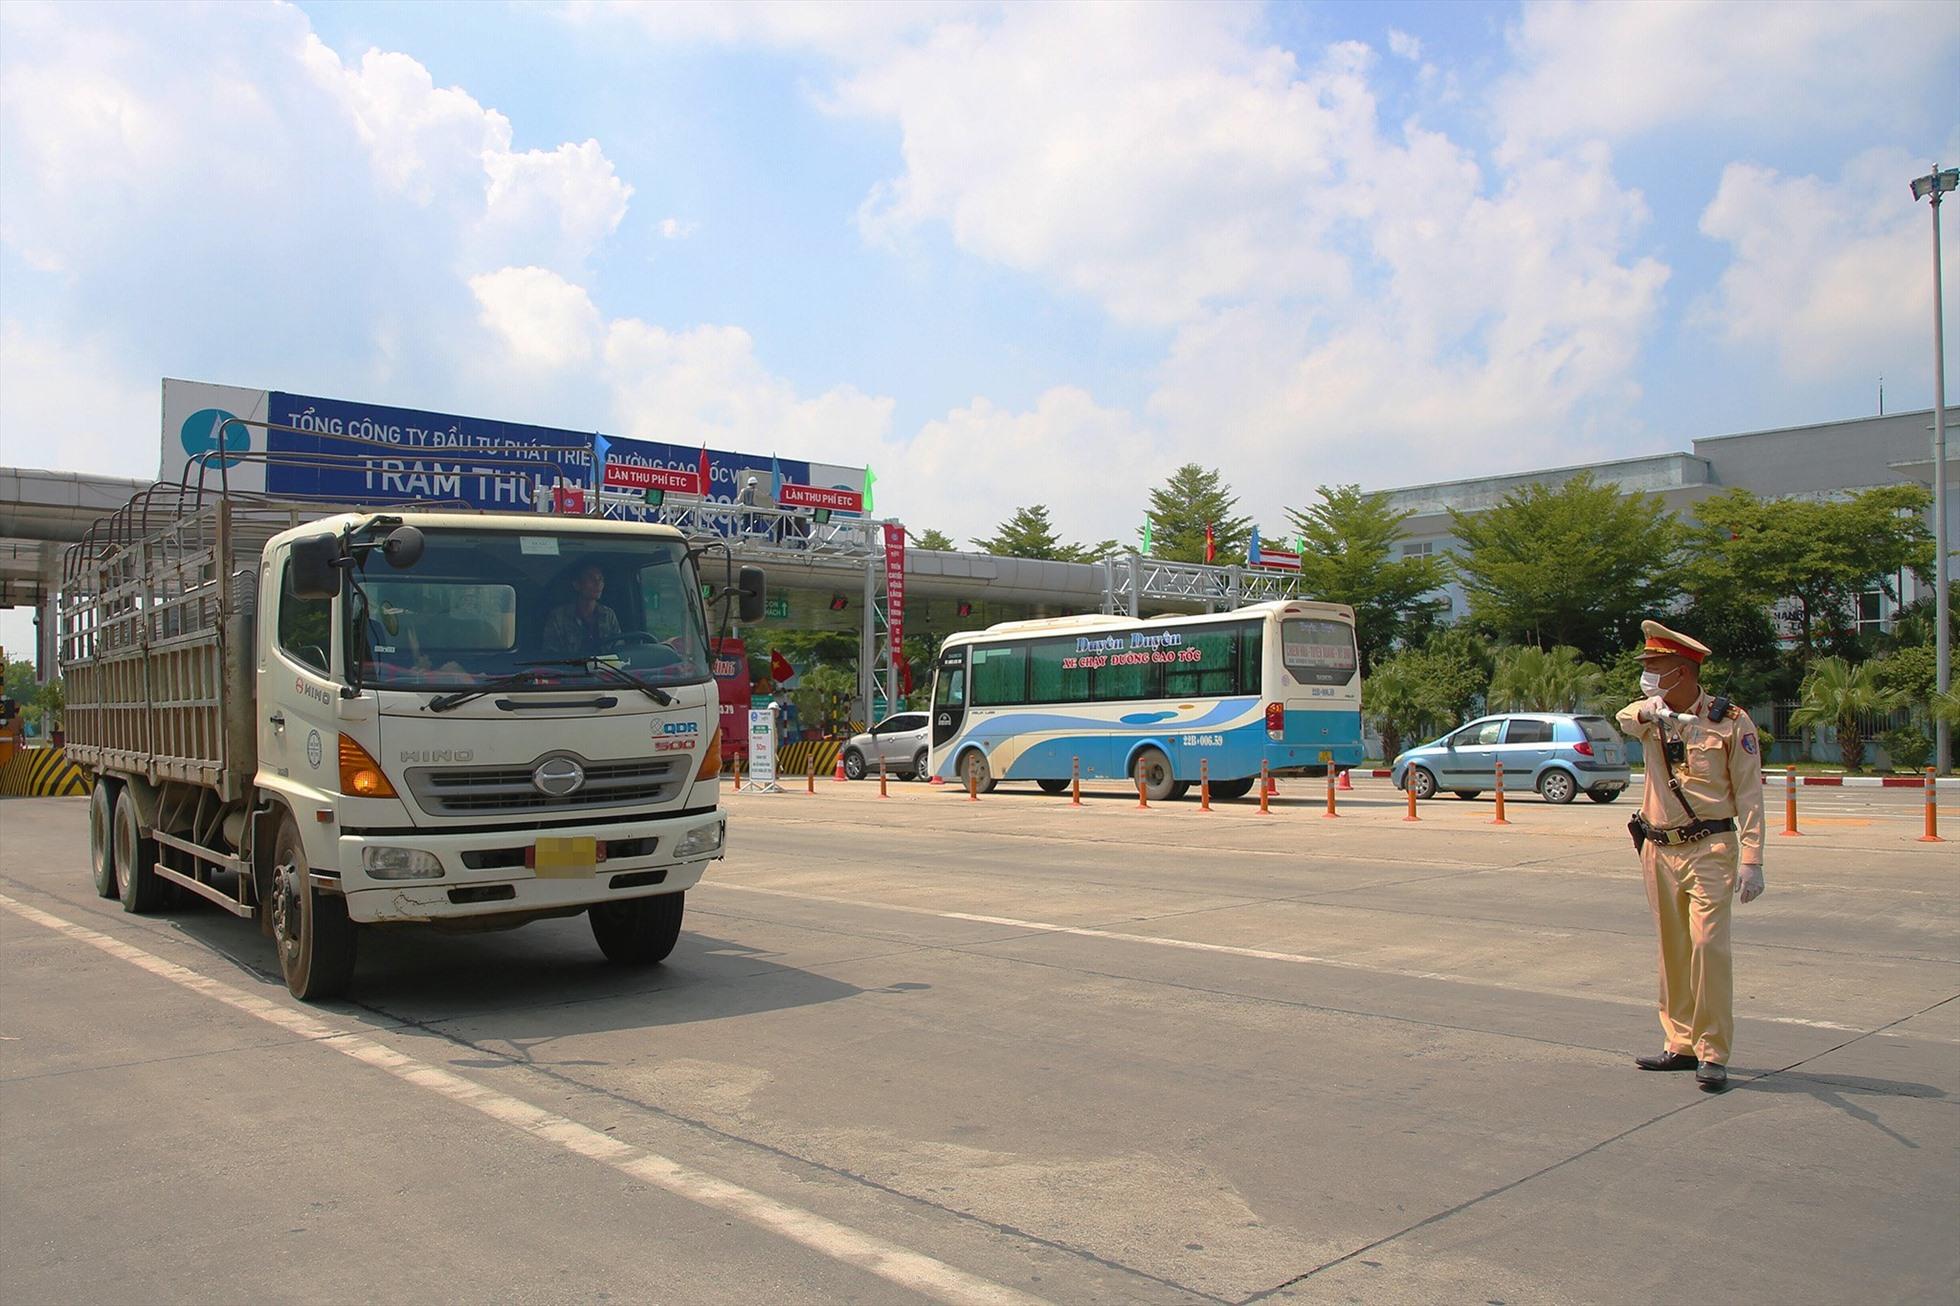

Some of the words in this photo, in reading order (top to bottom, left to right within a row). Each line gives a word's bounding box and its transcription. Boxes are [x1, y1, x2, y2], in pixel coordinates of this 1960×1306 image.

[288, 407, 343, 435] TỔNG
[348, 417, 401, 443] CÔNG
[405, 427, 429, 446] TY
[433, 426, 472, 450] ĐẦU
[505, 438, 551, 462] PHÁT
[555, 442, 592, 467] TRIỂ
[358, 455, 460, 500] TRẠM
[472, 467, 541, 505] THU
[608, 467, 629, 481] LÀN
[631, 471, 651, 483] THU
[652, 474, 668, 486] PHÍ
[669, 477, 688, 487] ETC
[786, 488, 804, 501] LÀN
[805, 491, 822, 503] THU
[822, 492, 838, 505] PHÍ
[838, 496, 853, 506] ETC
[1076, 635, 1124, 655] Duyên
[1129, 630, 1182, 651] Duyên
[1063, 658, 1077, 668] XE
[1079, 656, 1108, 669] CHẠY
[1151, 651, 1176, 662] CAO
[1178, 646, 1202, 662] TỐC
[304, 684, 330, 705] HINO
[663, 722, 698, 734] QDR
[400, 749, 474, 763] HINO
[655, 740, 696, 752] 500
